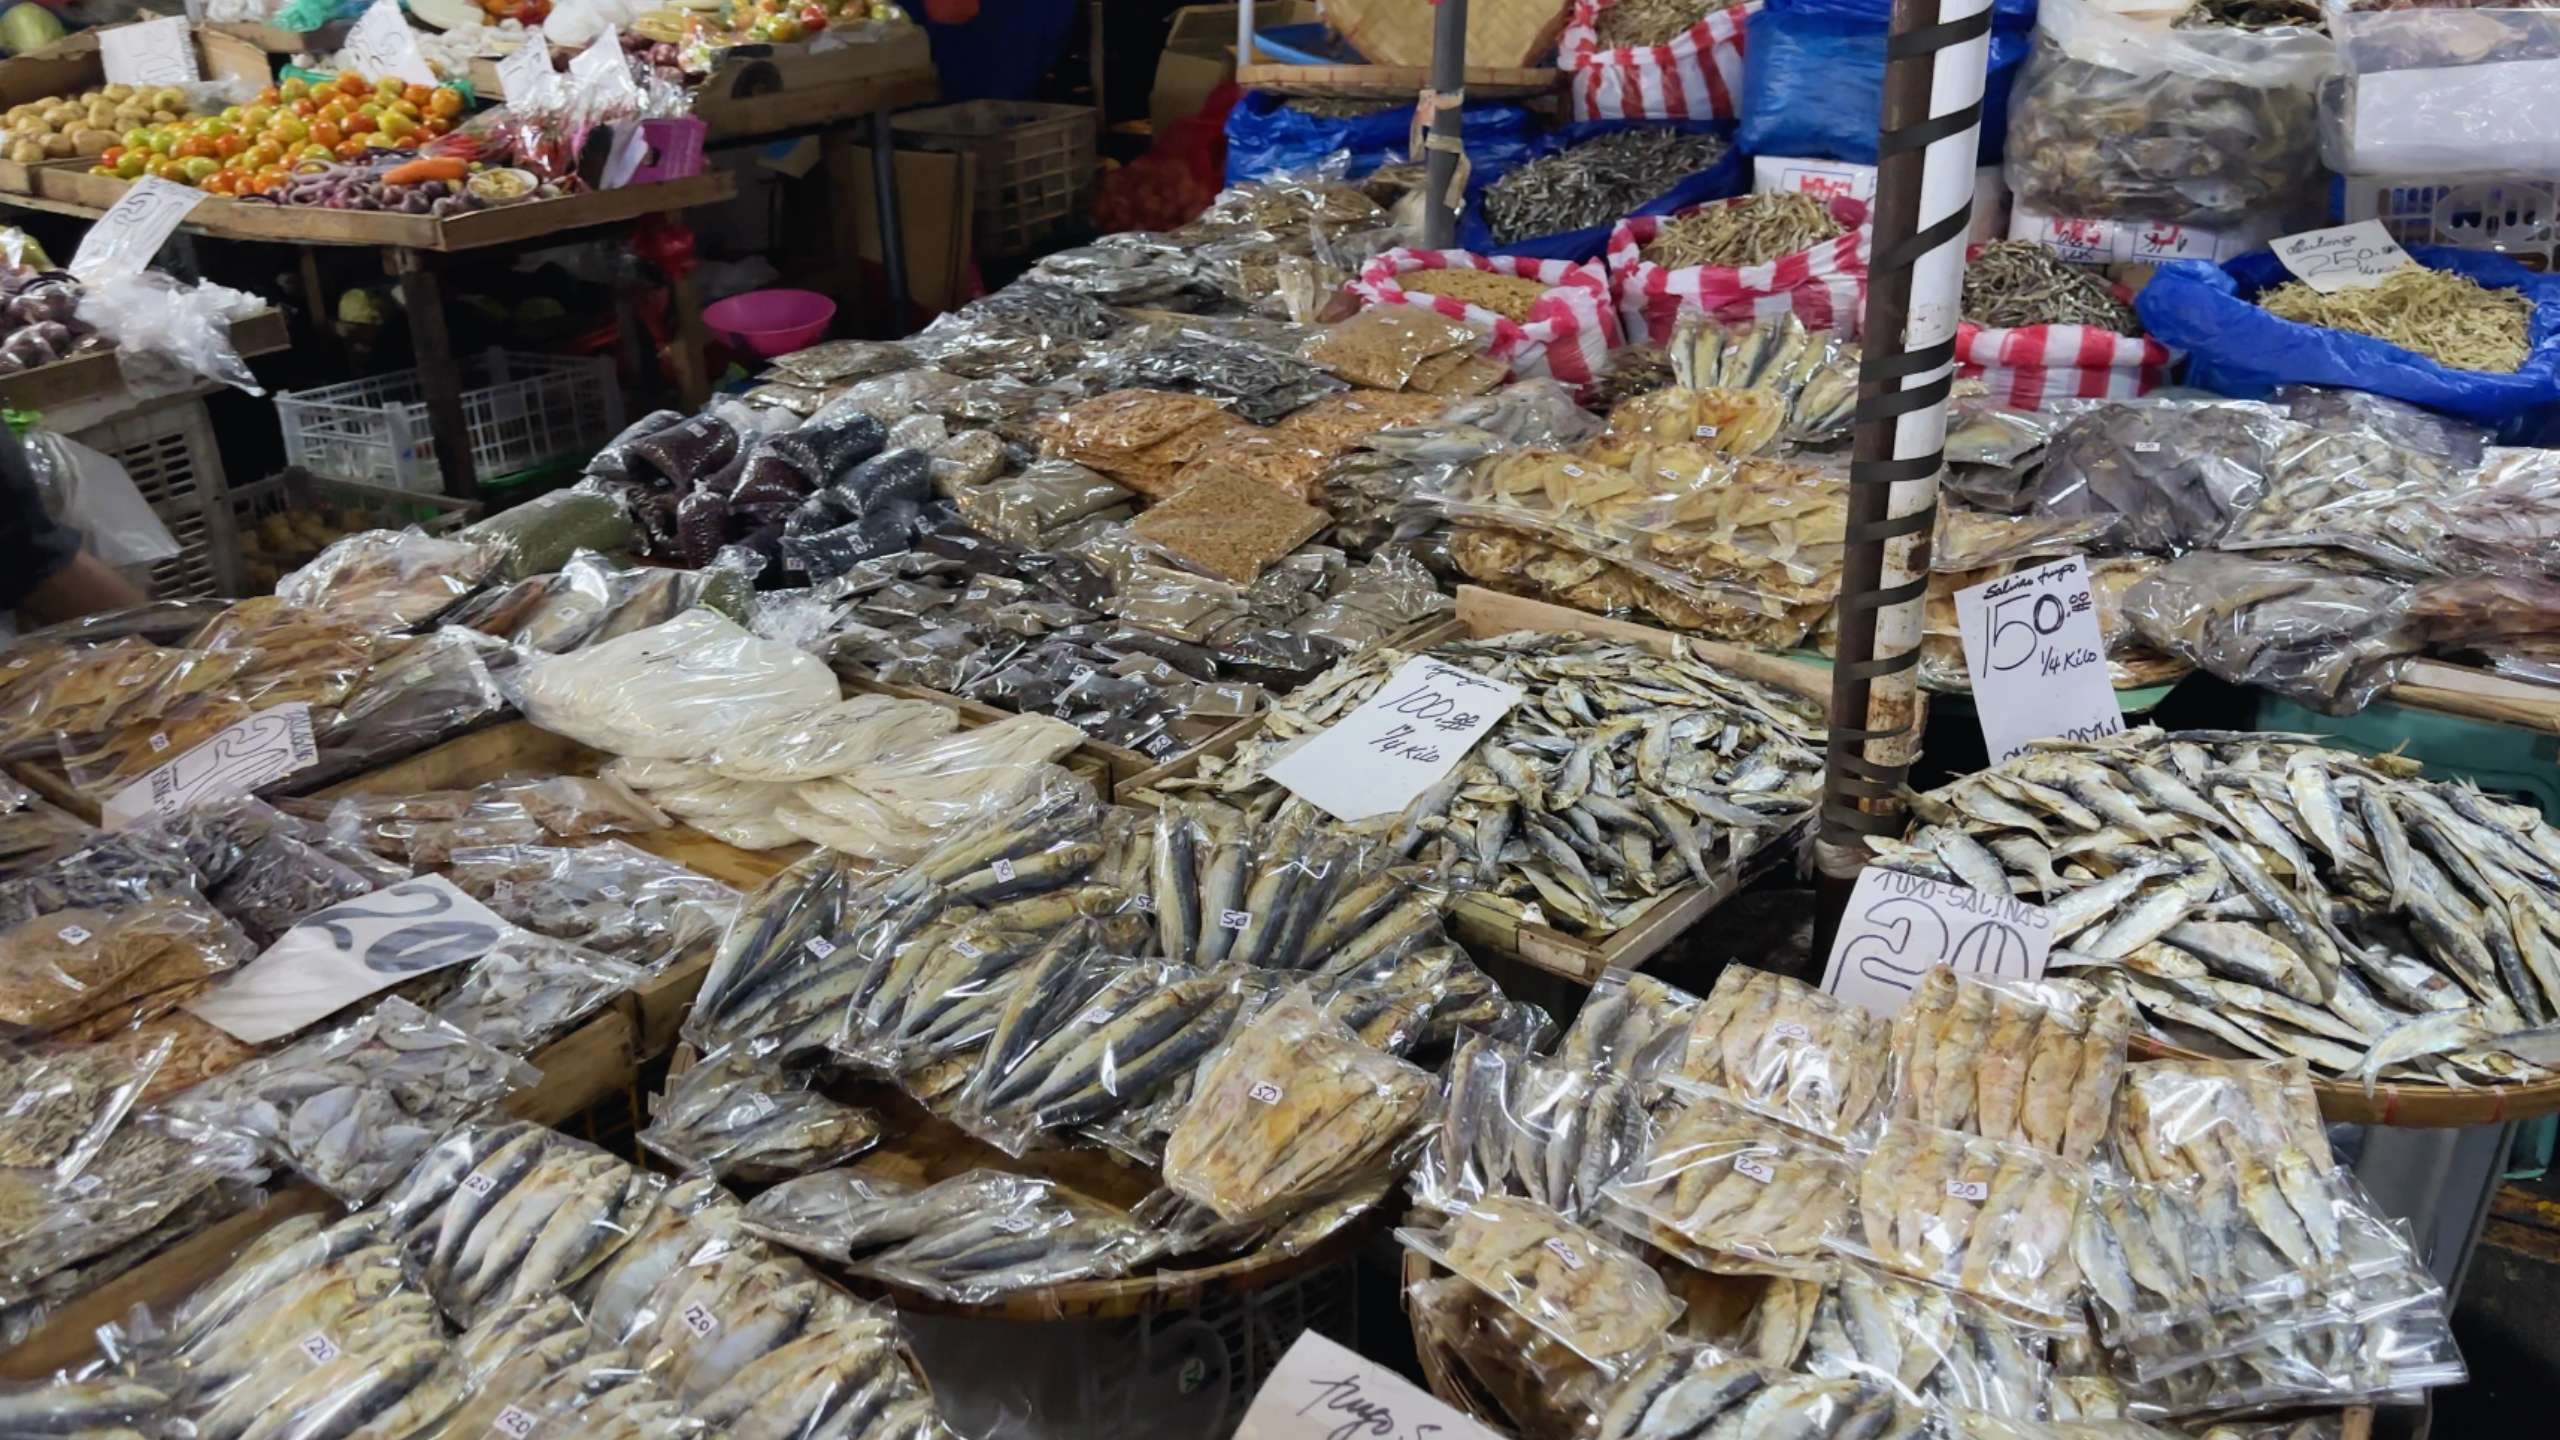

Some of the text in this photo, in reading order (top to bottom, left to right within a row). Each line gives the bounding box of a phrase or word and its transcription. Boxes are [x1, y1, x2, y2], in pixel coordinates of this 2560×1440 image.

[2041, 646, 2060, 677] 1/4
[299, 885, 502, 973] 20
[1740, 1158, 1763, 1175] 20
[1952, 1182, 1978, 1197] 20
